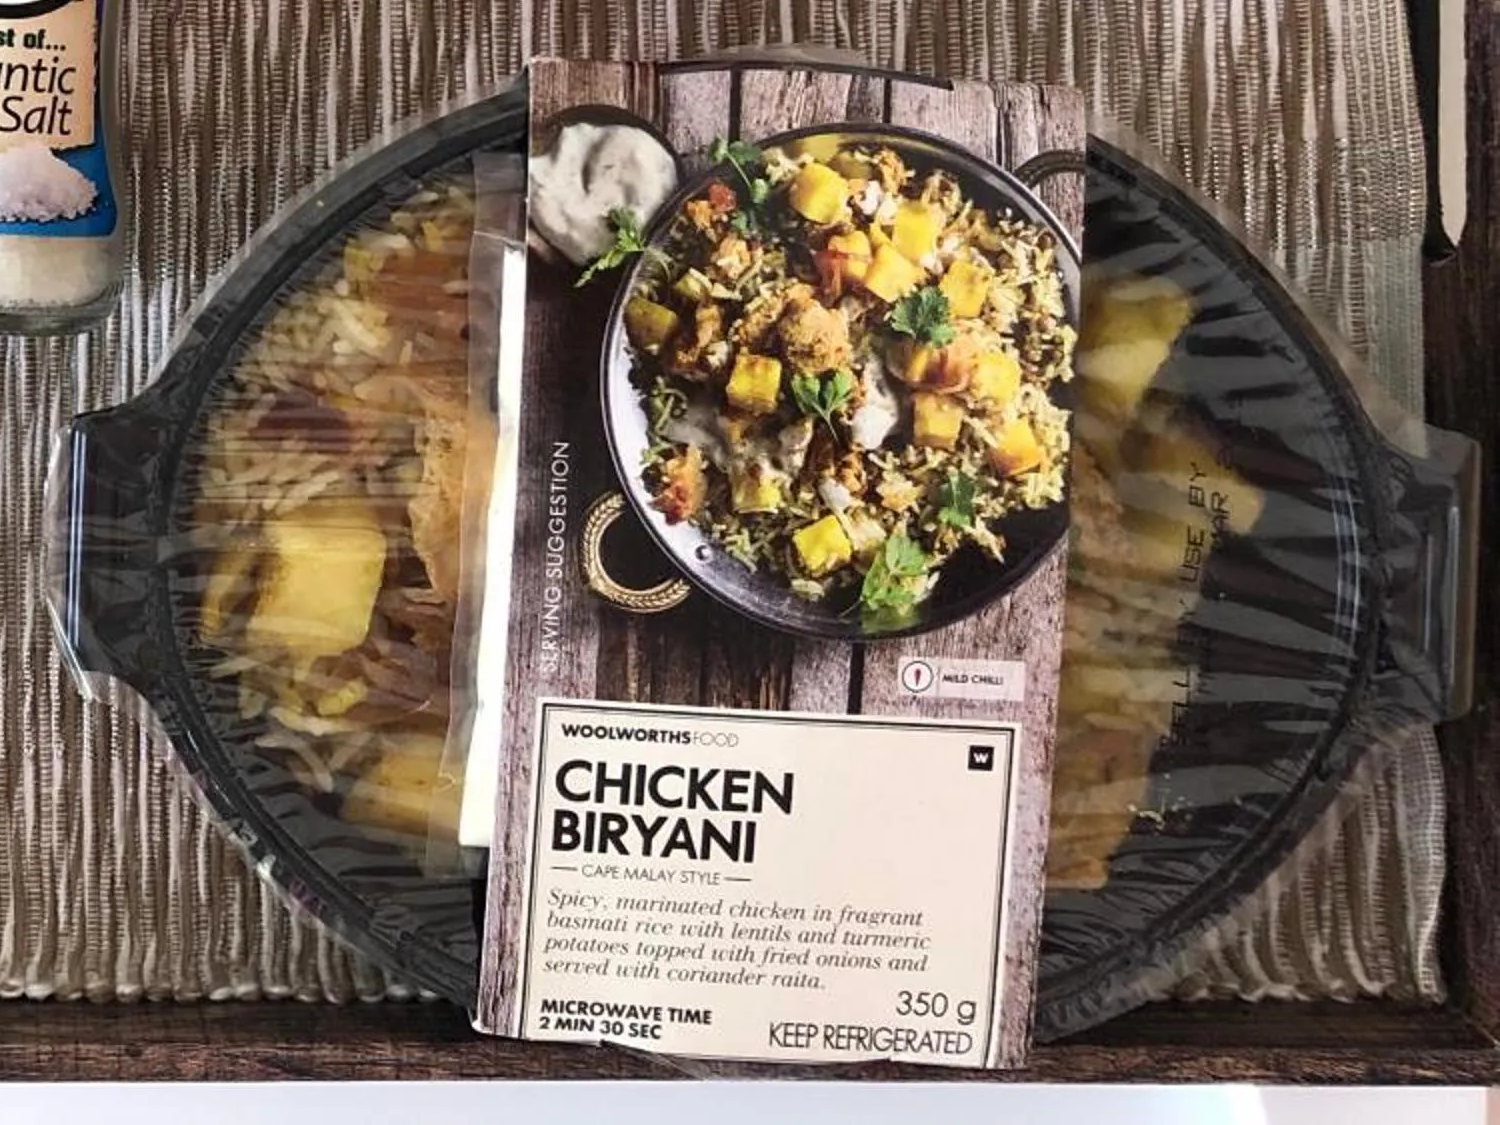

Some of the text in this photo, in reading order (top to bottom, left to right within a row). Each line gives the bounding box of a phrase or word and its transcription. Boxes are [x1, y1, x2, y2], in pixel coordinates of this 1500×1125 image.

[0, 96, 73, 135] Salt
[541, 441, 570, 672] SERVING SUGGESTION
[561, 723, 740, 748] WOOLWORTHSFOOD
[555, 760, 795, 814] CHICKEN
[551, 810, 757, 863] BIRYANI
[581, 865, 720, 886] CAPE MALAY STYLE
[547, 889, 924, 931] Spicy, marinated chicken in fragrant
[546, 911, 932, 949] basmati rice with lentils and turmeric
[543, 936, 929, 972] potatoes topped with fried onions and
[543, 958, 825, 989] served with coriander raita.
[540, 999, 713, 1026] MICROWAVE TIME
[895, 991, 977, 1027] 350 g
[539, 1017, 662, 1039] 2 MIN 30 SEC
[768, 1023, 974, 1054] KEEP REFRIGERATED
